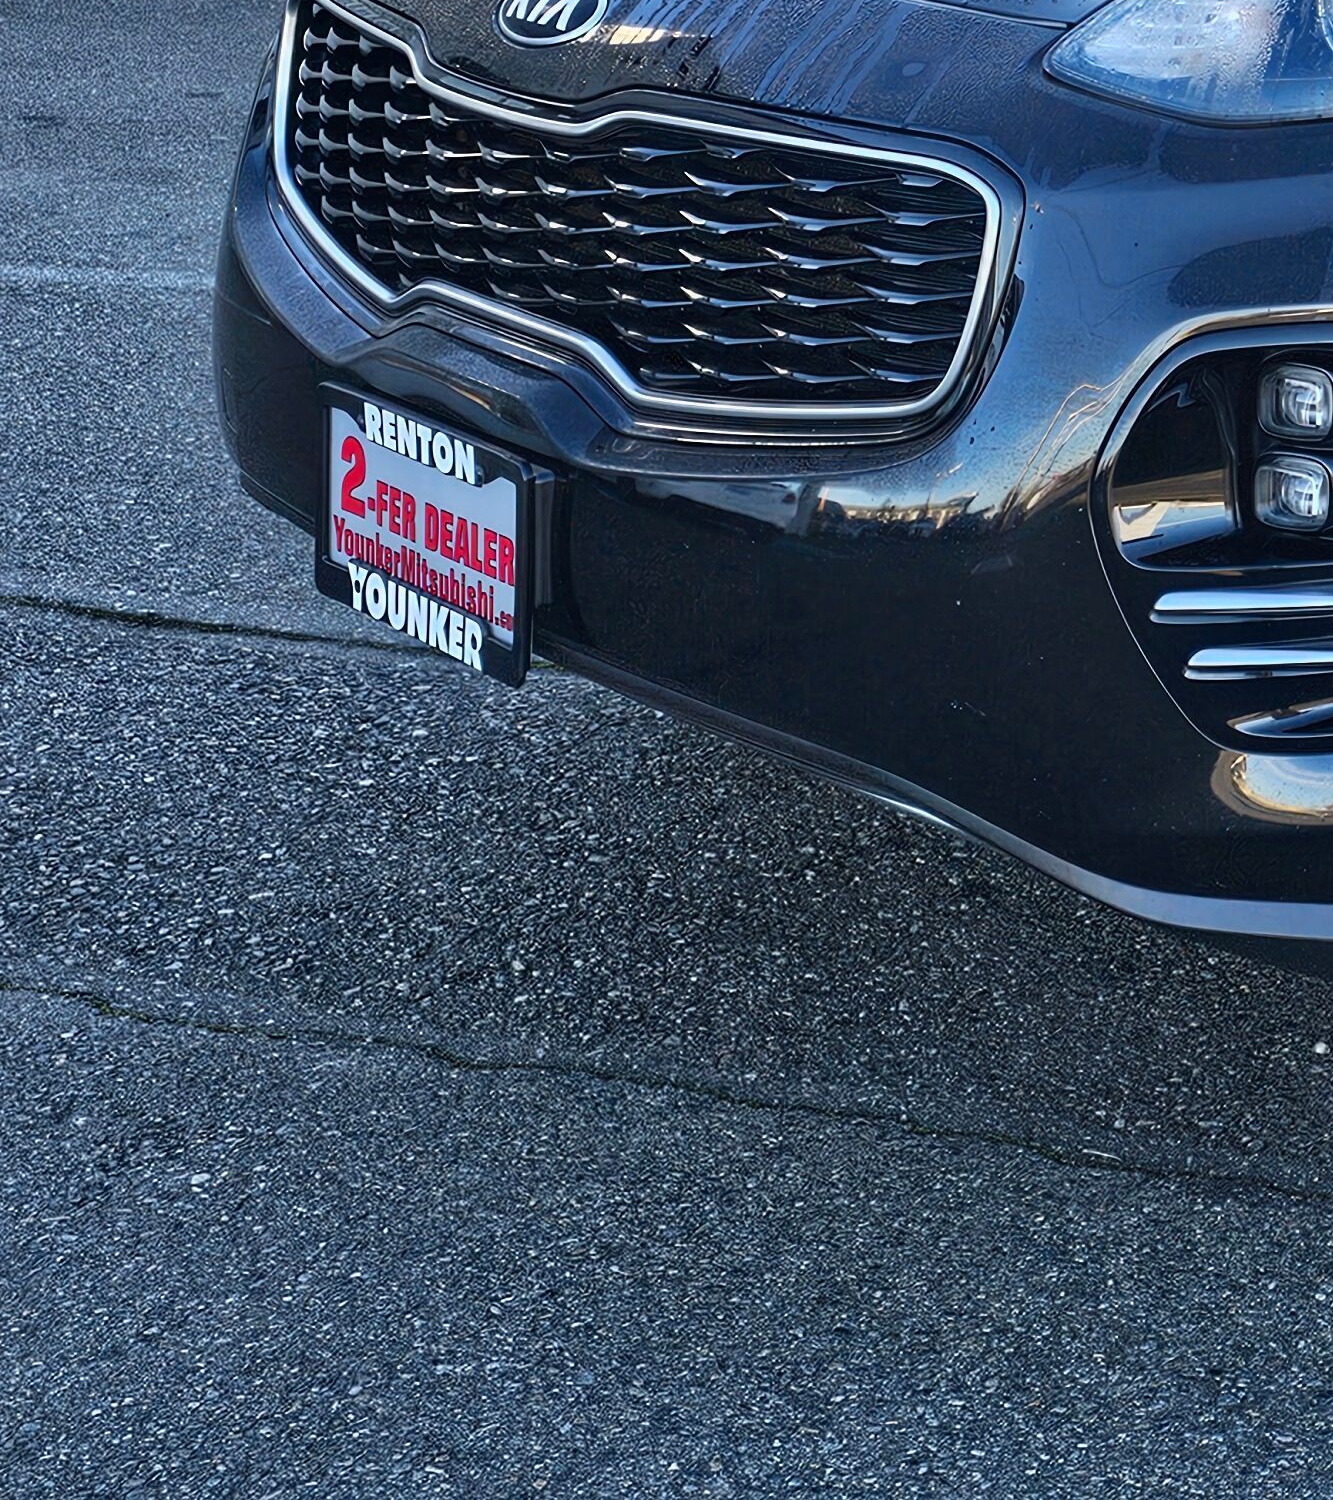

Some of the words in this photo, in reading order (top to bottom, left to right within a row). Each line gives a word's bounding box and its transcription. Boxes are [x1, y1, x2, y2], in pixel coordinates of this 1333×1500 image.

[363, 401, 478, 485] RENTON
[424, 502, 515, 586] DEALER
[348, 561, 484, 672] YOUNKER
